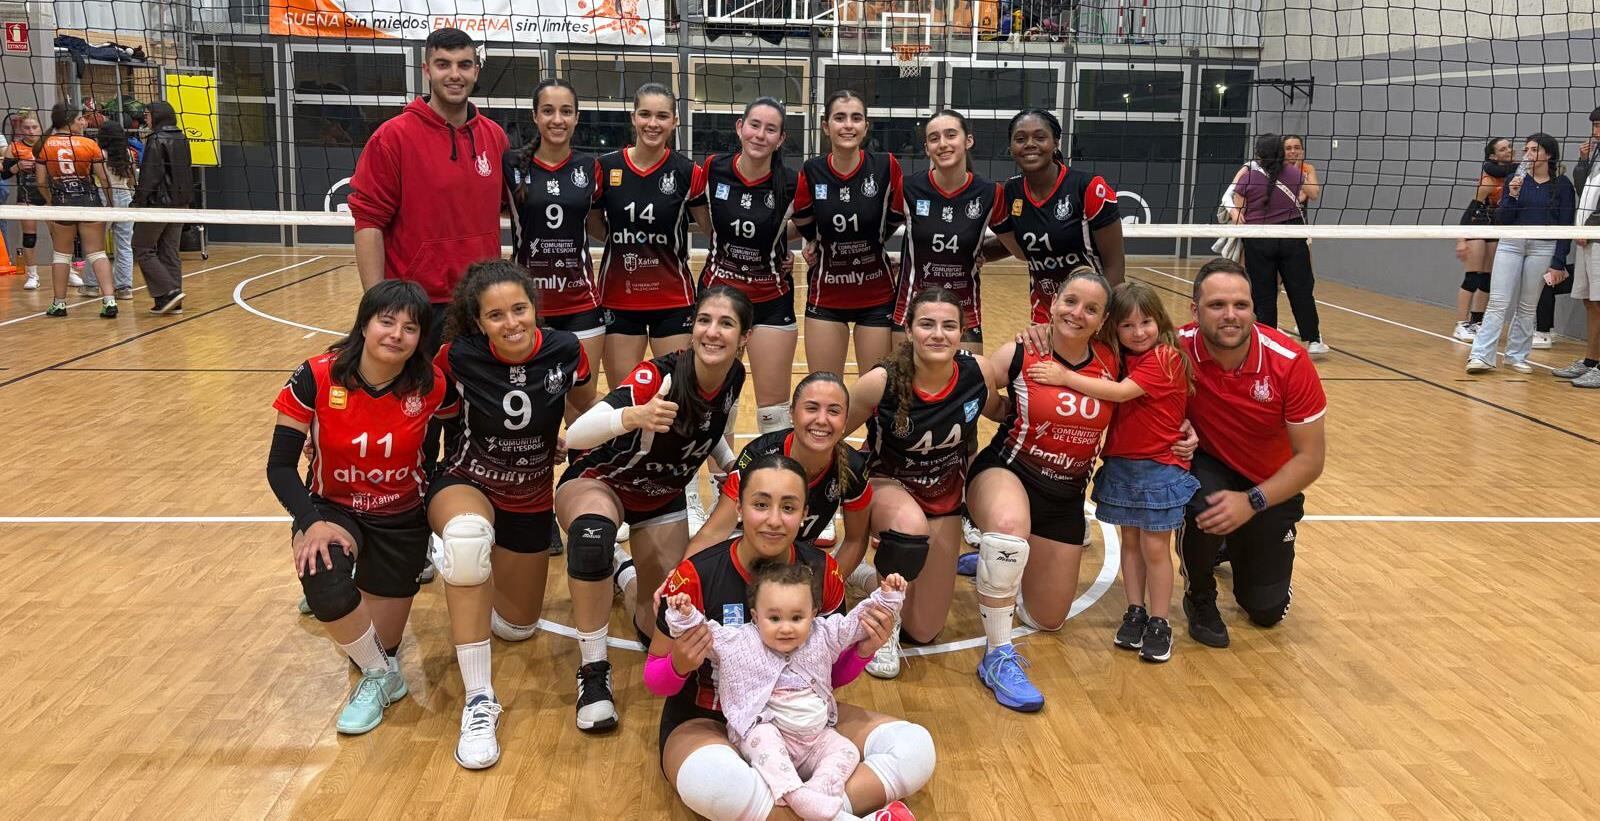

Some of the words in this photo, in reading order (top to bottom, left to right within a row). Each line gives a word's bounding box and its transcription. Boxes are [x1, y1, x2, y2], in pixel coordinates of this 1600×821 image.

[282, 11, 340, 27] SUEÑA
[345, 15, 366, 29] sin
[372, 16, 428, 30] miedos
[433, 16, 510, 32] ENTRENA
[515, 18, 537, 32] sin
[57, 148, 76, 174] 6
[545, 203, 564, 230] 9
[624, 201, 656, 225] 14
[832, 213, 859, 233] 91
[612, 228, 668, 245] ahora
[730, 218, 756, 239] 19
[931, 233, 959, 254] 54
[1022, 232, 1053, 252] 21
[824, 271, 865, 285] family
[865, 269, 883, 281] cash
[502, 389, 532, 430] 9
[1055, 391, 1101, 420] 30
[352, 432, 393, 458] 11
[498, 437, 542, 447] COMUNITAT
[513, 442, 545, 453] L'ESPORT
[905, 423, 964, 455] 44
[1053, 433, 1066, 442] DE
[681, 438, 713, 460] 14
[1029, 444, 1075, 470] family
[333, 465, 410, 484] ahora
[468, 458, 527, 485] family
